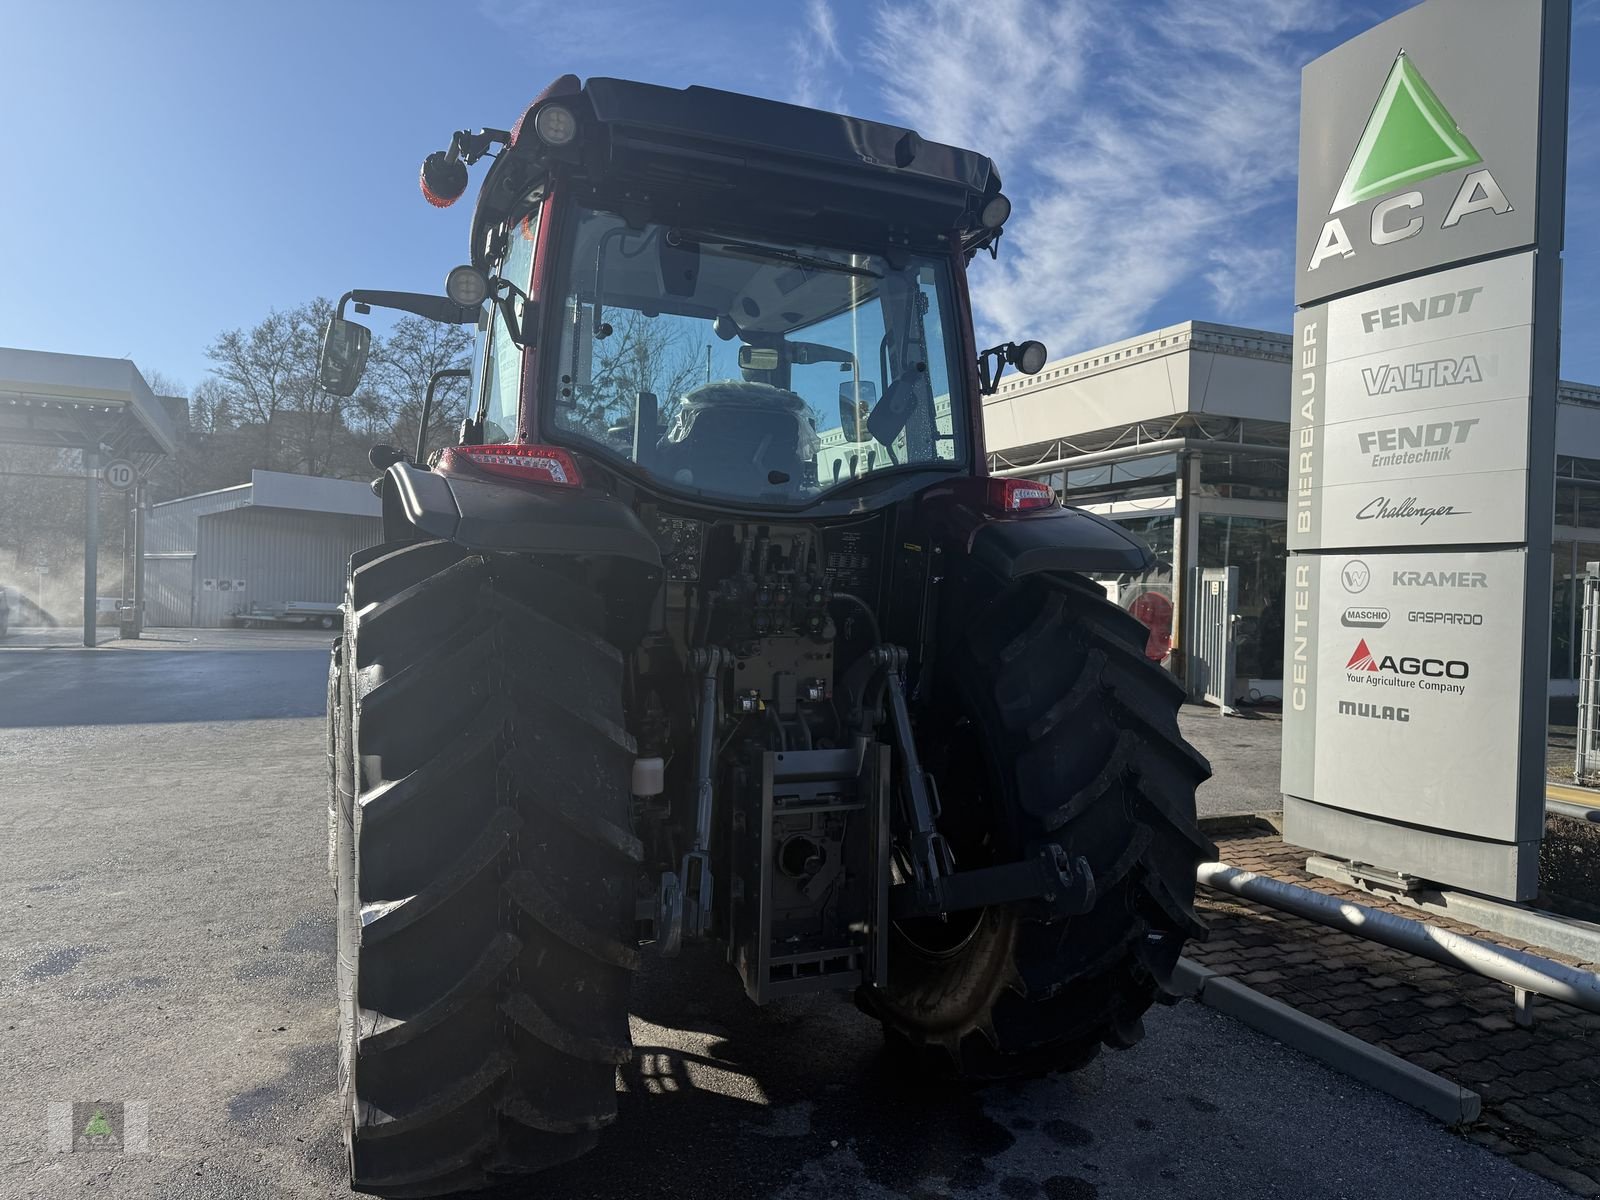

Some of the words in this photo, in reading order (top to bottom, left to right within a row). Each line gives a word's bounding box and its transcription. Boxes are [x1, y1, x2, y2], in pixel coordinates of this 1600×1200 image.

[1307, 169, 1514, 272] ACA
[1361, 286, 1484, 333] FENDT
[1361, 355, 1483, 396] VALTRA
[1297, 322, 1317, 533] BIERBAUER
[1358, 418, 1480, 454] FENDT
[1371, 447, 1453, 467] Erntetechnik
[112, 468, 129, 482] 10
[1355, 496, 1472, 525] Challenger
[1392, 571, 1488, 588] KRAMER
[1347, 611, 1388, 620] MASCHIO
[1408, 611, 1483, 625] GASPARDO
[1293, 565, 1309, 711] CENTER
[1379, 655, 1469, 680] AGCO
[1346, 672, 1364, 684] Your
[1366, 675, 1416, 689] Agriculture
[1418, 679, 1466, 695] Company
[1339, 700, 1410, 722] MULAG
